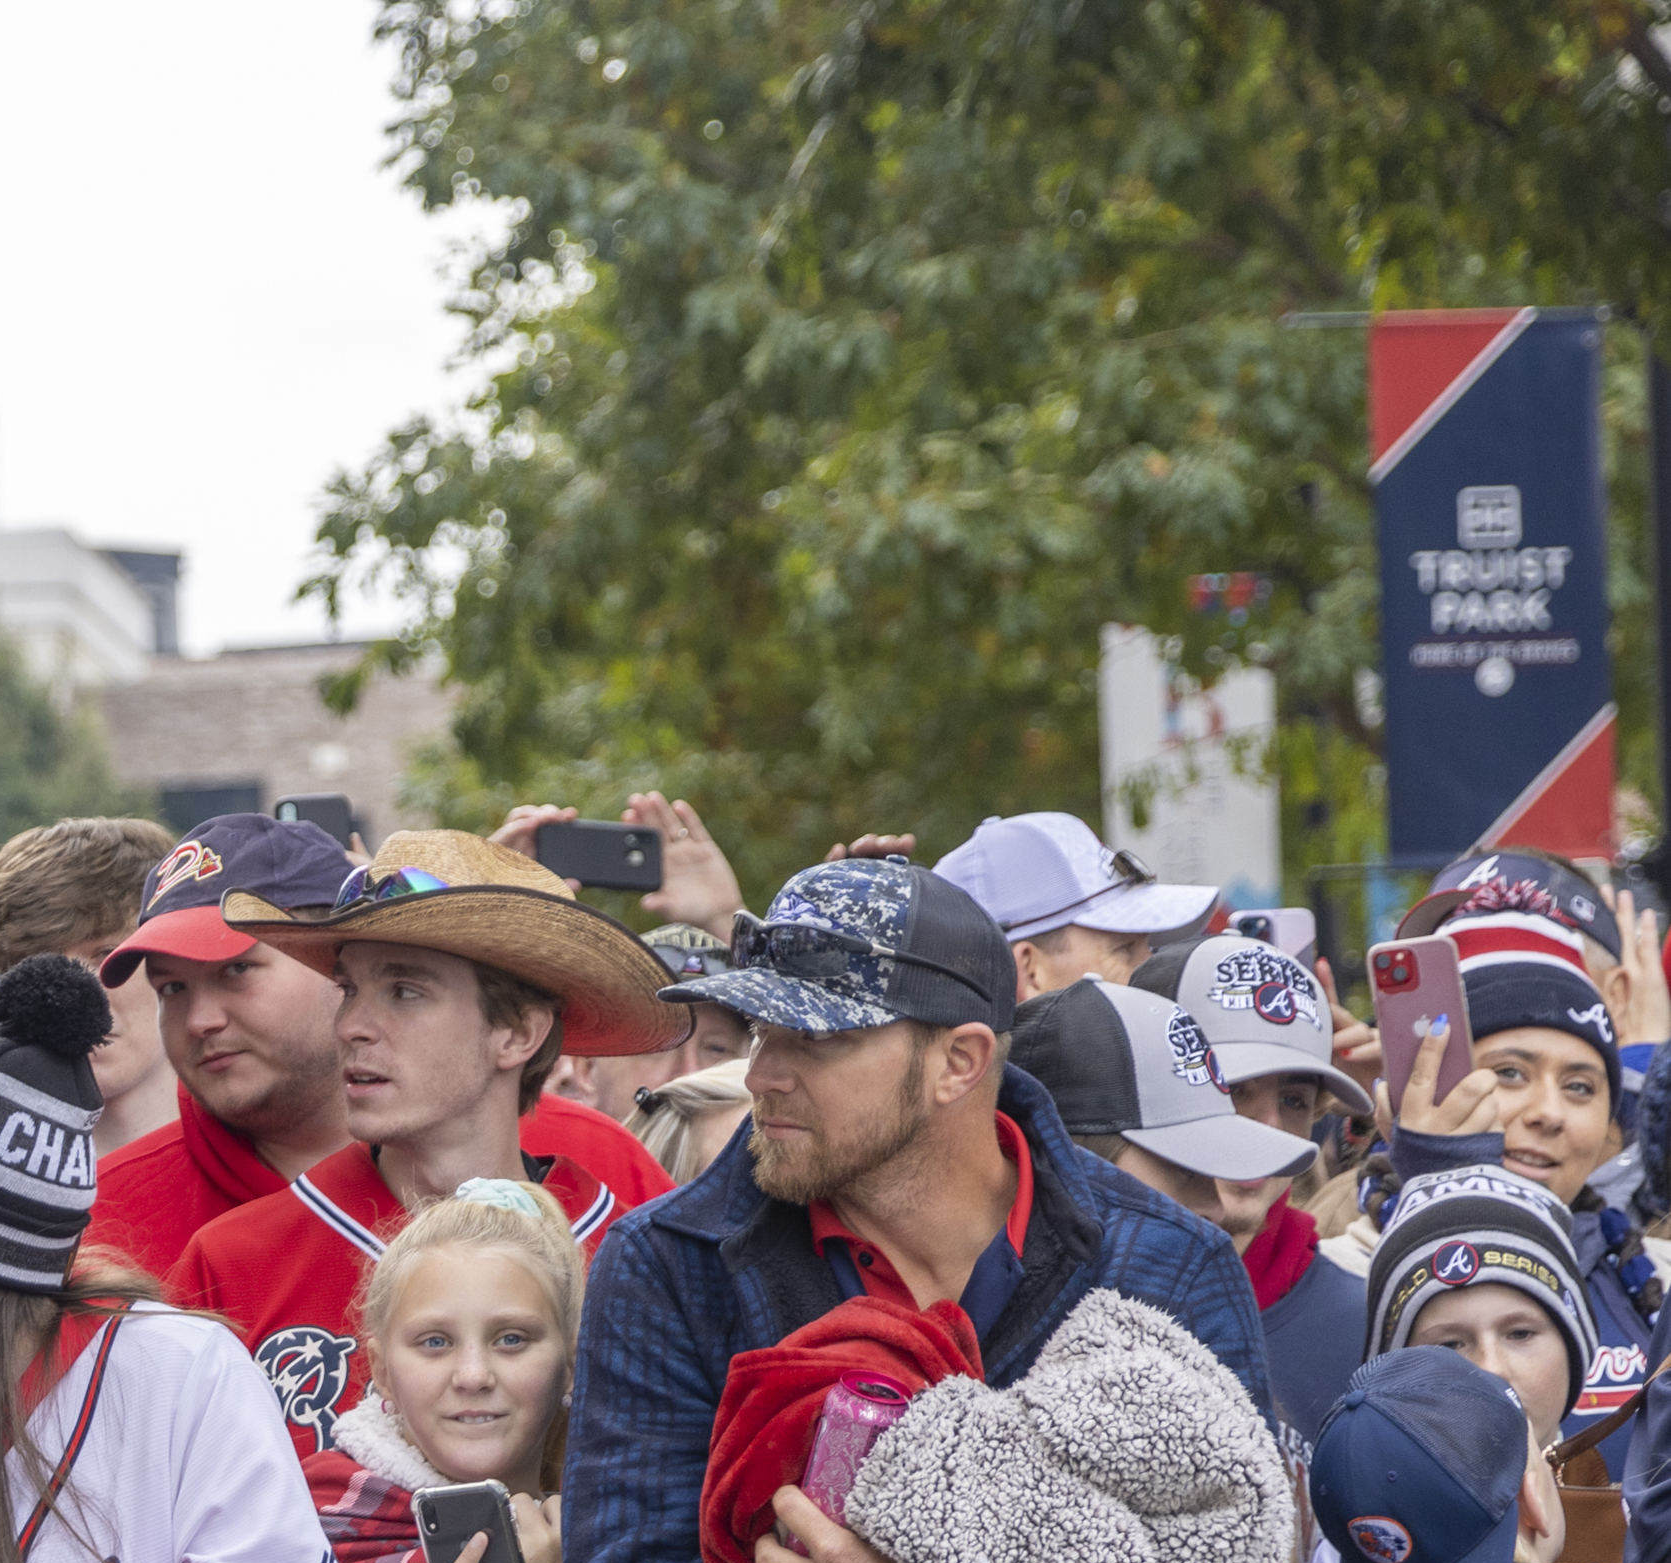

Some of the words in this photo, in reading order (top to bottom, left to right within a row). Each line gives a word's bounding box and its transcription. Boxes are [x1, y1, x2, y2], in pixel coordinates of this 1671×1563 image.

[1409, 546, 1574, 594] TRUIST
[1430, 588, 1553, 634] PARK
[1457, 855, 1499, 890] A
[1262, 988, 1291, 1016] A
[1439, 1244, 1472, 1277] A
[1483, 1251, 1558, 1291] SERIES
